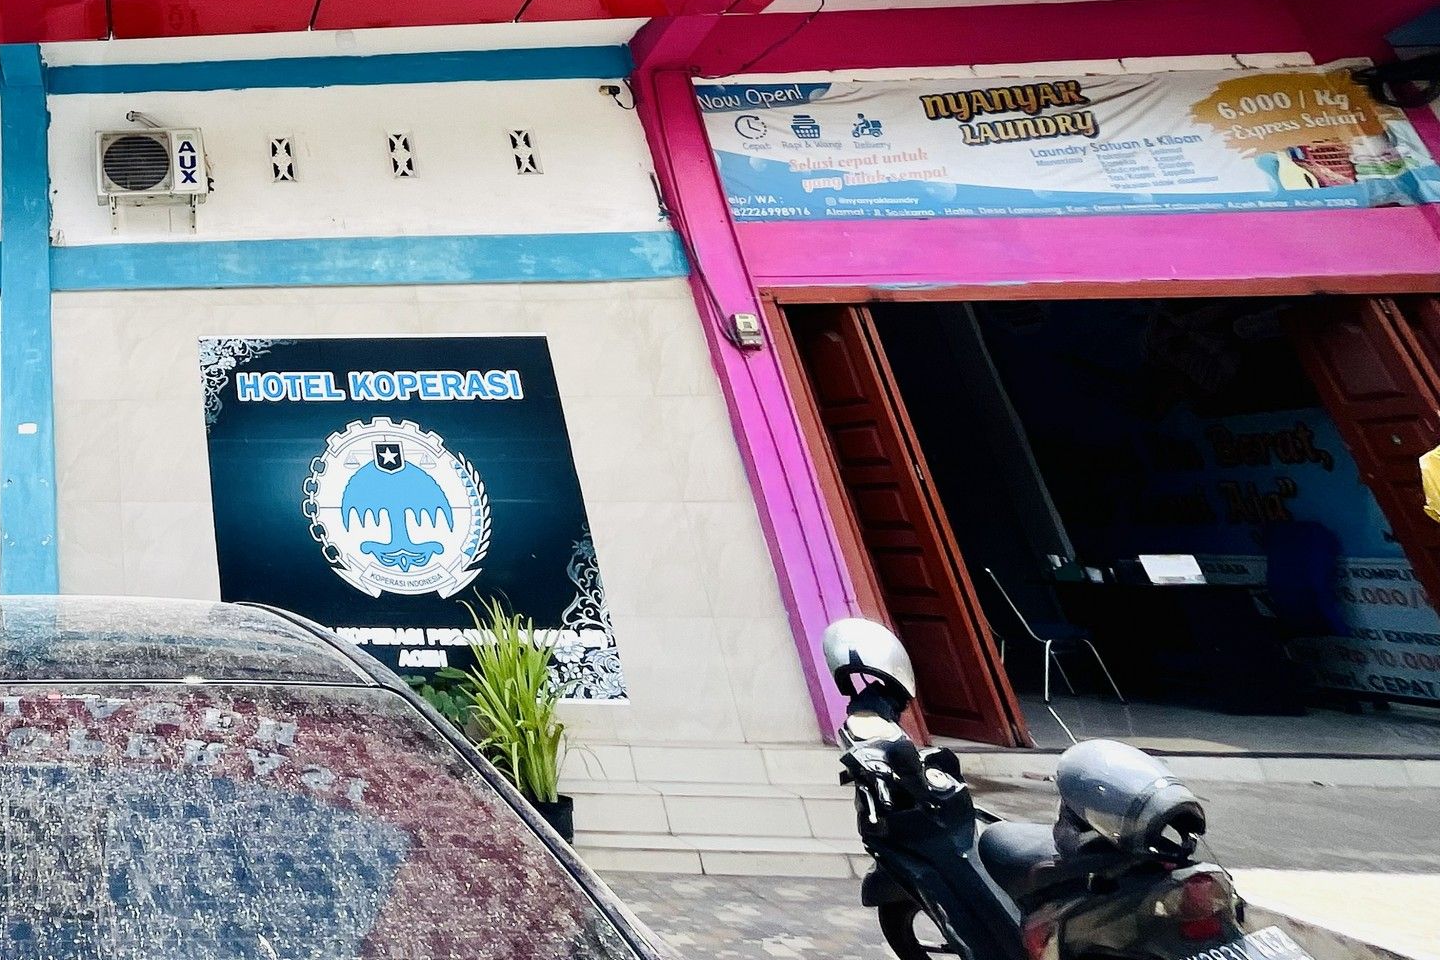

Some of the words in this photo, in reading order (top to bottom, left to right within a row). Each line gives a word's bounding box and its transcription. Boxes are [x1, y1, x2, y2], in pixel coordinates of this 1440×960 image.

[696, 93, 741, 110] Now
[745, 84, 804, 109] Open!
[1215, 91, 1291, 120] 6.000
[1313, 88, 1349, 110] Kg
[959, 111, 1100, 146] LAUNDRY
[1232, 119, 1301, 140] Express
[1301, 107, 1367, 128] Sehari
[742, 142, 772, 151] Cepat
[1031, 144, 1086, 158] Laundry
[1090, 140, 1141, 153] Satuan
[1144, 138, 1154, 148] &
[1158, 134, 1203, 146] Kiloan
[177, 141, 198, 184] AUX
[790, 156, 833, 170] Solusi
[838, 153, 878, 170] cepat
[755, 195, 777, 204] WA
[236, 372, 345, 401] HOTEL
[350, 370, 524, 401] KOPERASI
[370, 572, 406, 588] KOPERASI
[407, 572, 444, 588] INDONESIA
